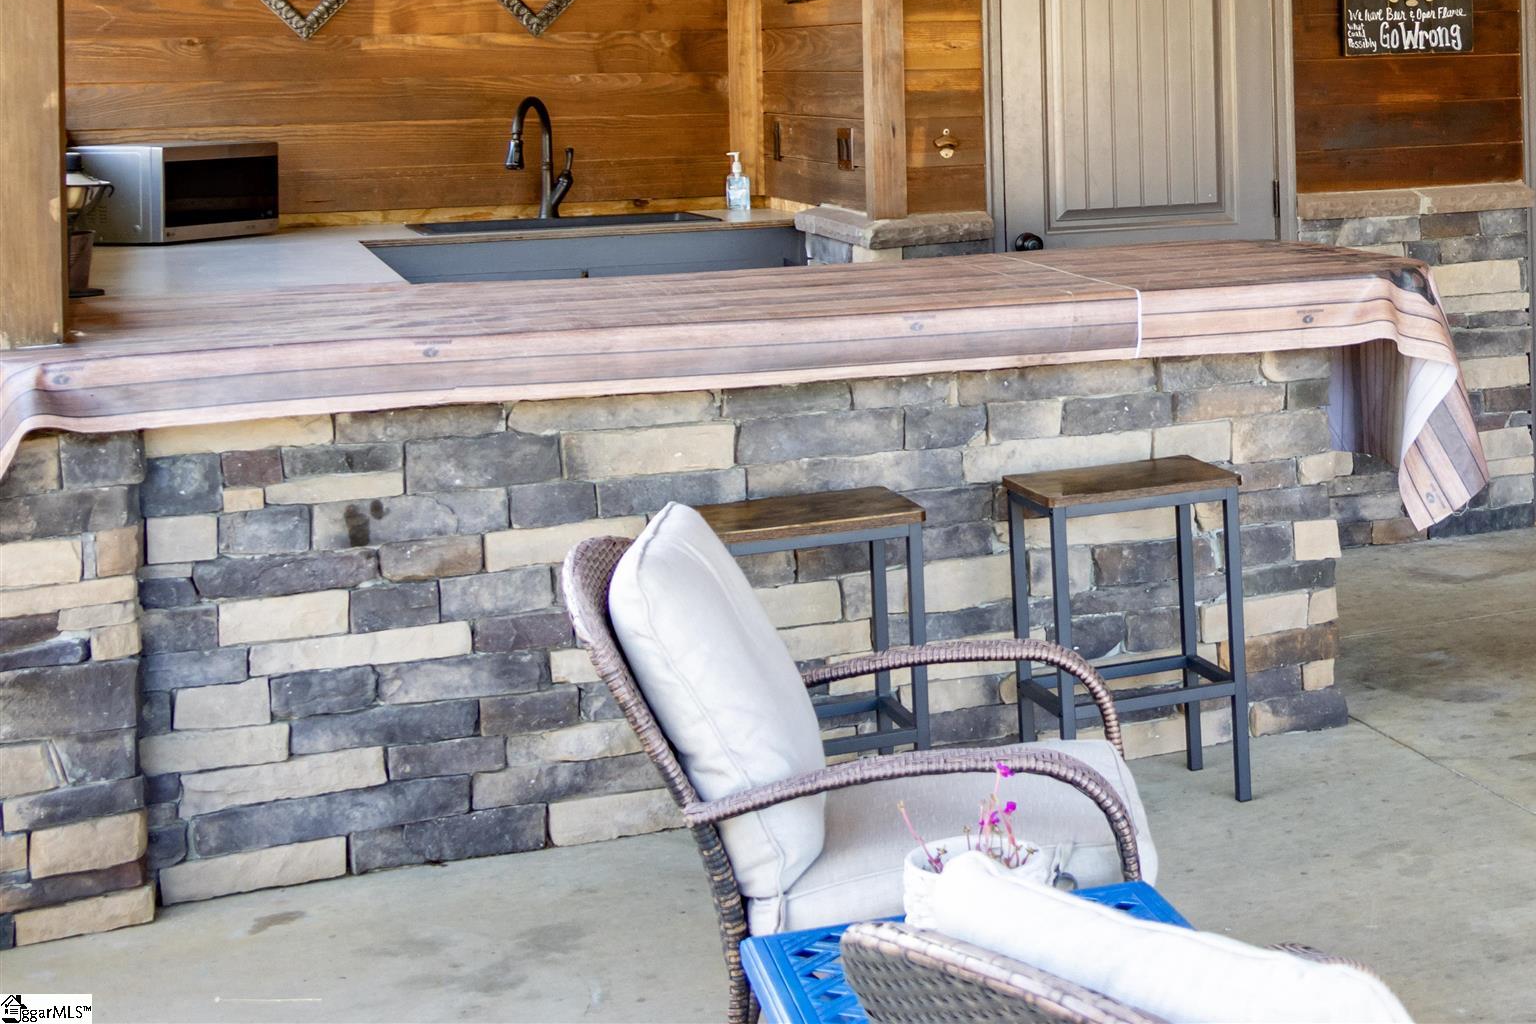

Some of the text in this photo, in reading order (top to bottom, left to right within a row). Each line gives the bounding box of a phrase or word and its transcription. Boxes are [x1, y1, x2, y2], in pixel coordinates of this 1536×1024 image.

[1347, 8, 1364, 22] We
[1364, 8, 1385, 22] have
[1386, 6, 1408, 21] Beer
[1416, 7, 1437, 23] Open
[1347, 37, 1377, 52] Possibly
